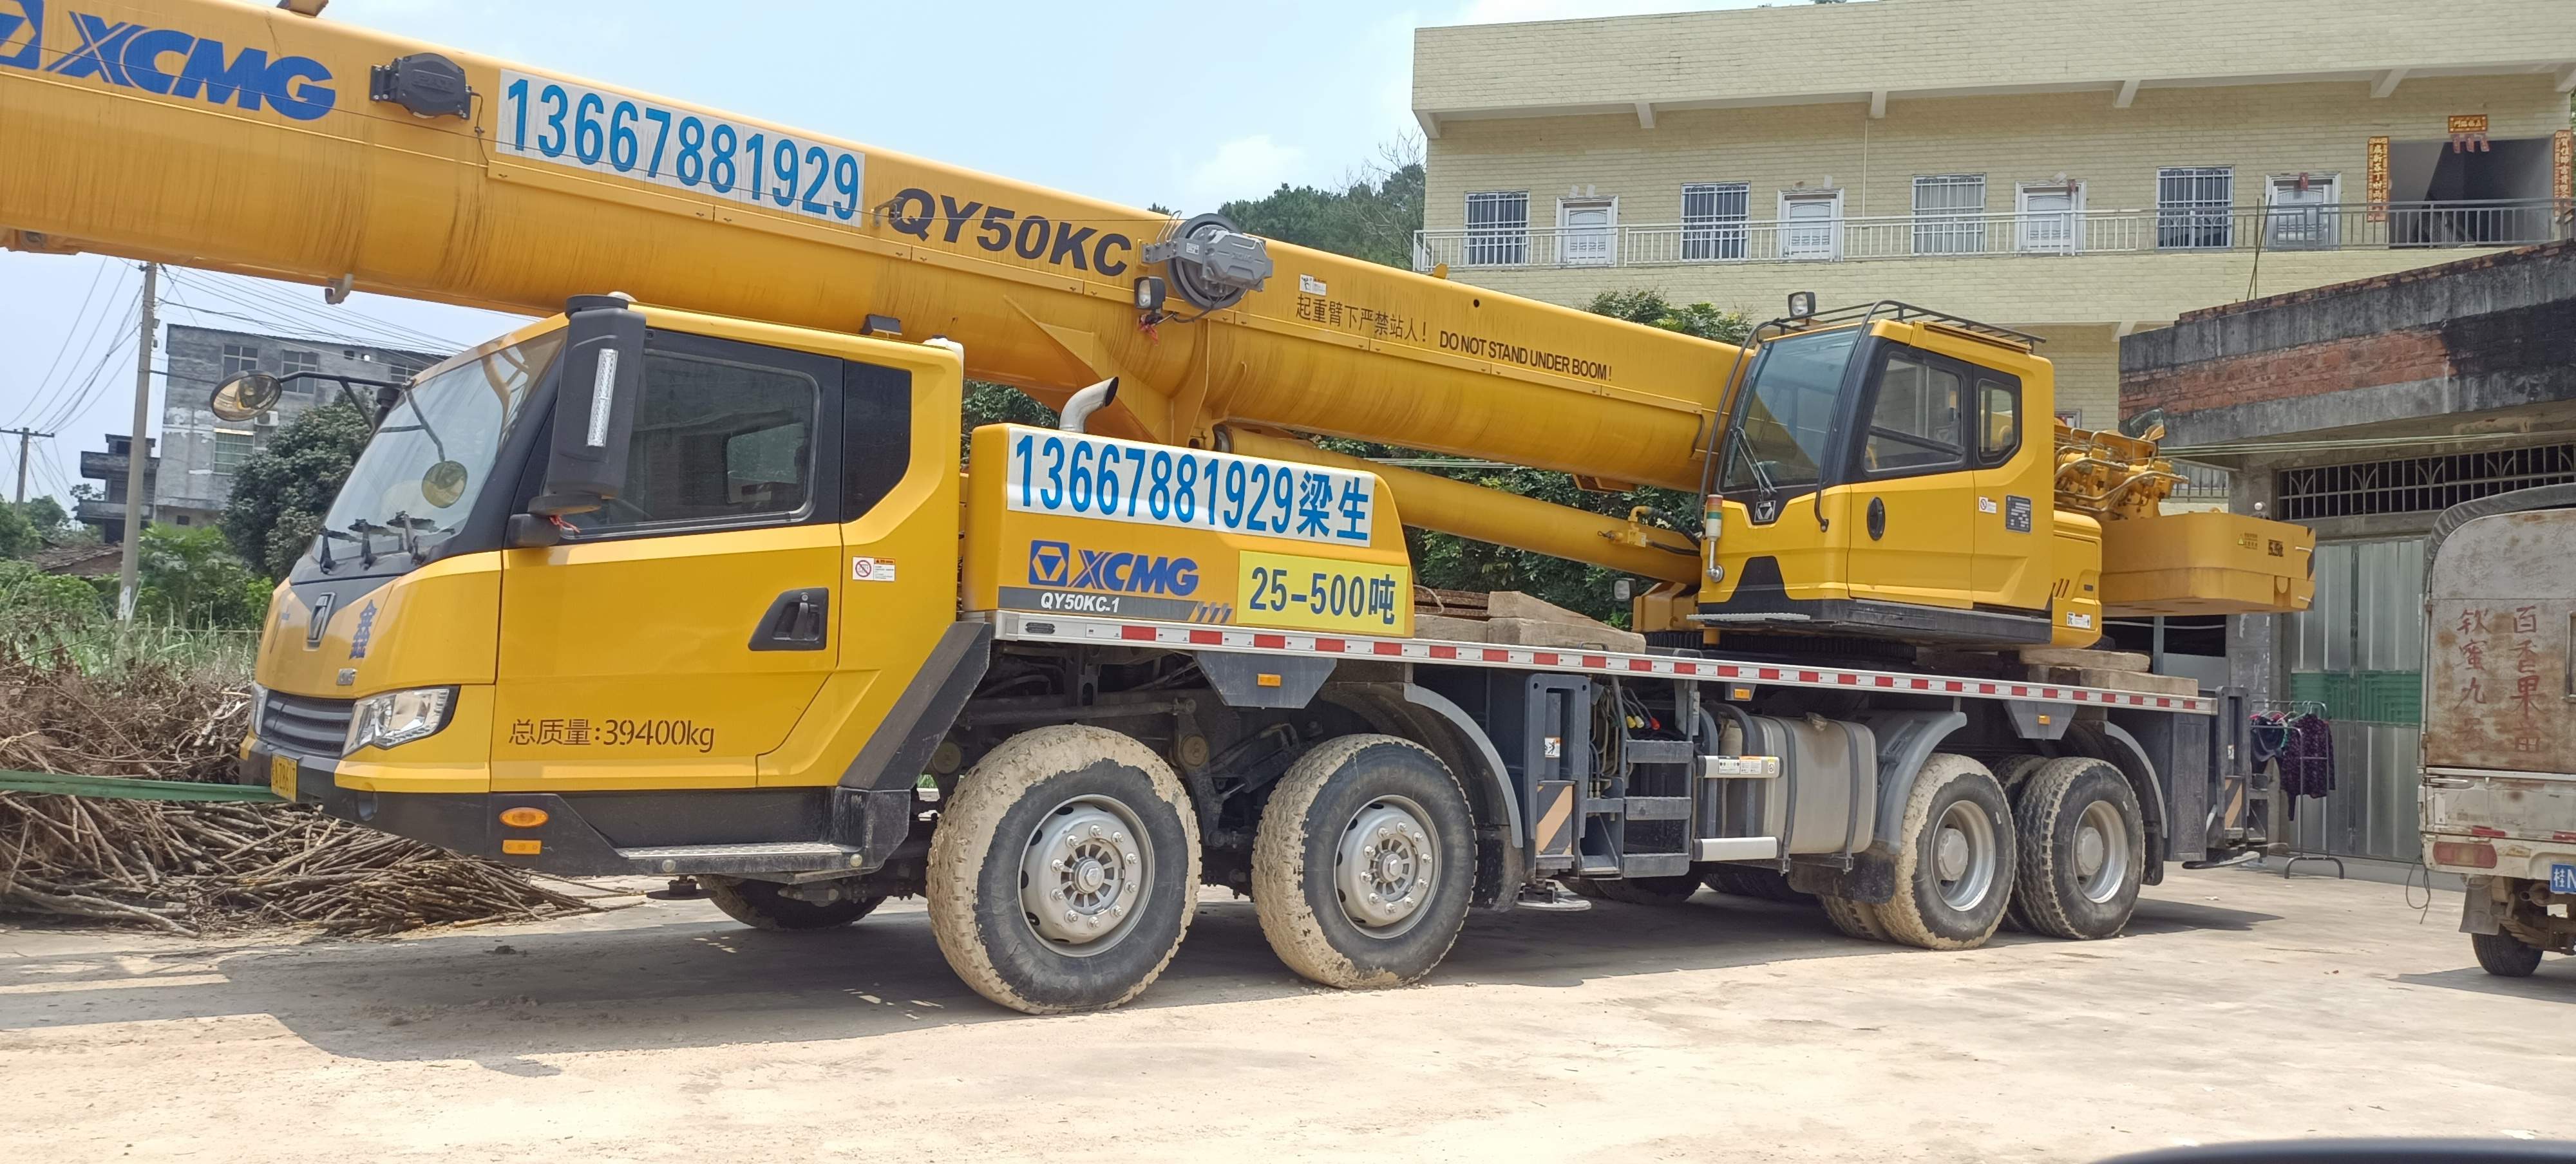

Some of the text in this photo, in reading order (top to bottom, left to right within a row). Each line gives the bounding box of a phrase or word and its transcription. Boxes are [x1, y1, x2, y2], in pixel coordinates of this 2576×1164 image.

[43, 10, 336, 120] XCMG
[508, 79, 859, 220] 13667881929
[890, 188, 1132, 277] QY50KC
[1296, 294, 1426, 342] 起重臂下严禁站人！
[1439, 330, 1459, 350] DO
[1461, 335, 1486, 356] NOT
[1488, 341, 1528, 364] STAND
[1530, 350, 1570, 373] UNDER
[1016, 435, 1369, 541] 13667881929梁生
[1068, 549, 1199, 597] XCMG
[1249, 567, 1396, 624] 25-500吨
[509, 718, 714, 753] 总质量:39400kg
